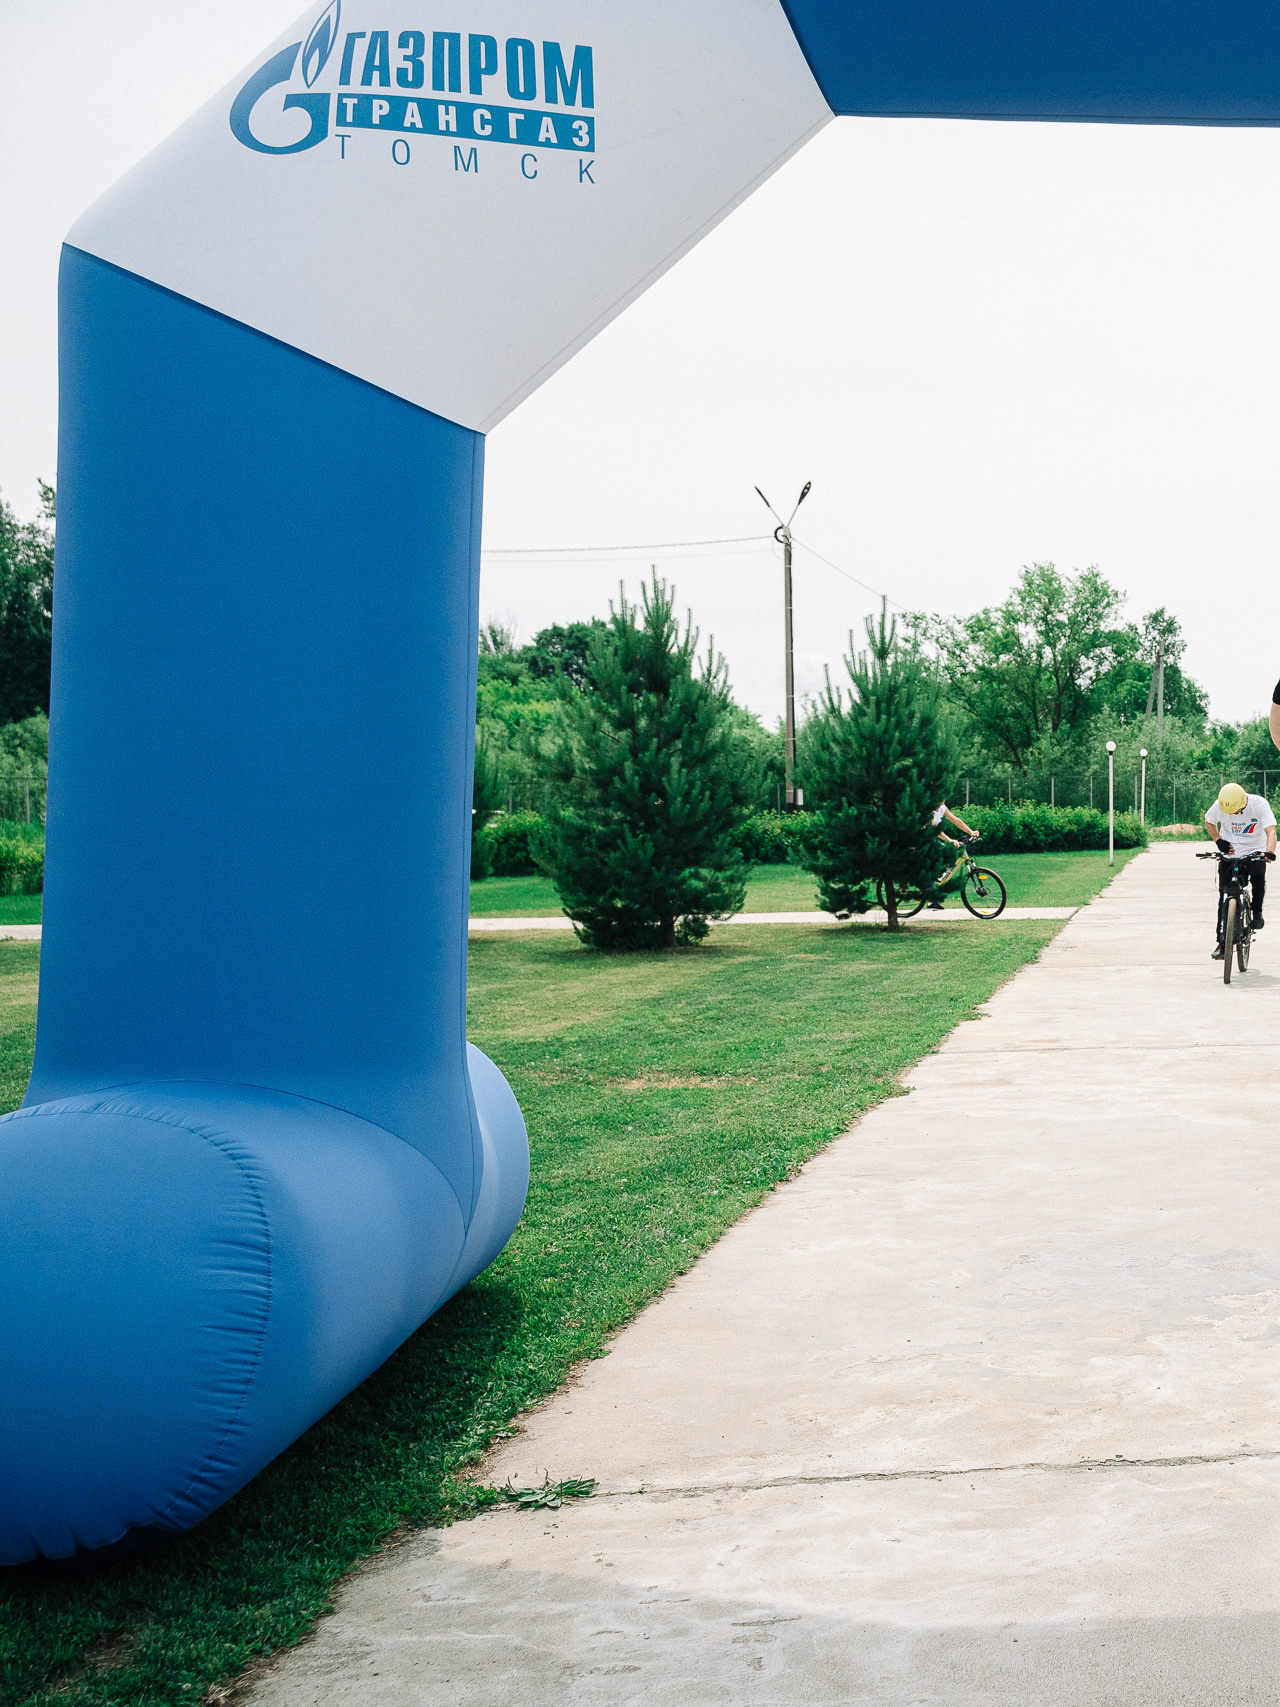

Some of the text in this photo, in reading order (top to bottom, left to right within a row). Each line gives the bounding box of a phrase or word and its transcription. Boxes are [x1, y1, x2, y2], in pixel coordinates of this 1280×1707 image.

[339, 30, 595, 109] ГАЗПРОМ
[341, 97, 591, 147] ТРАНСГАЗ
[335, 134, 596, 184] ТОМСК
